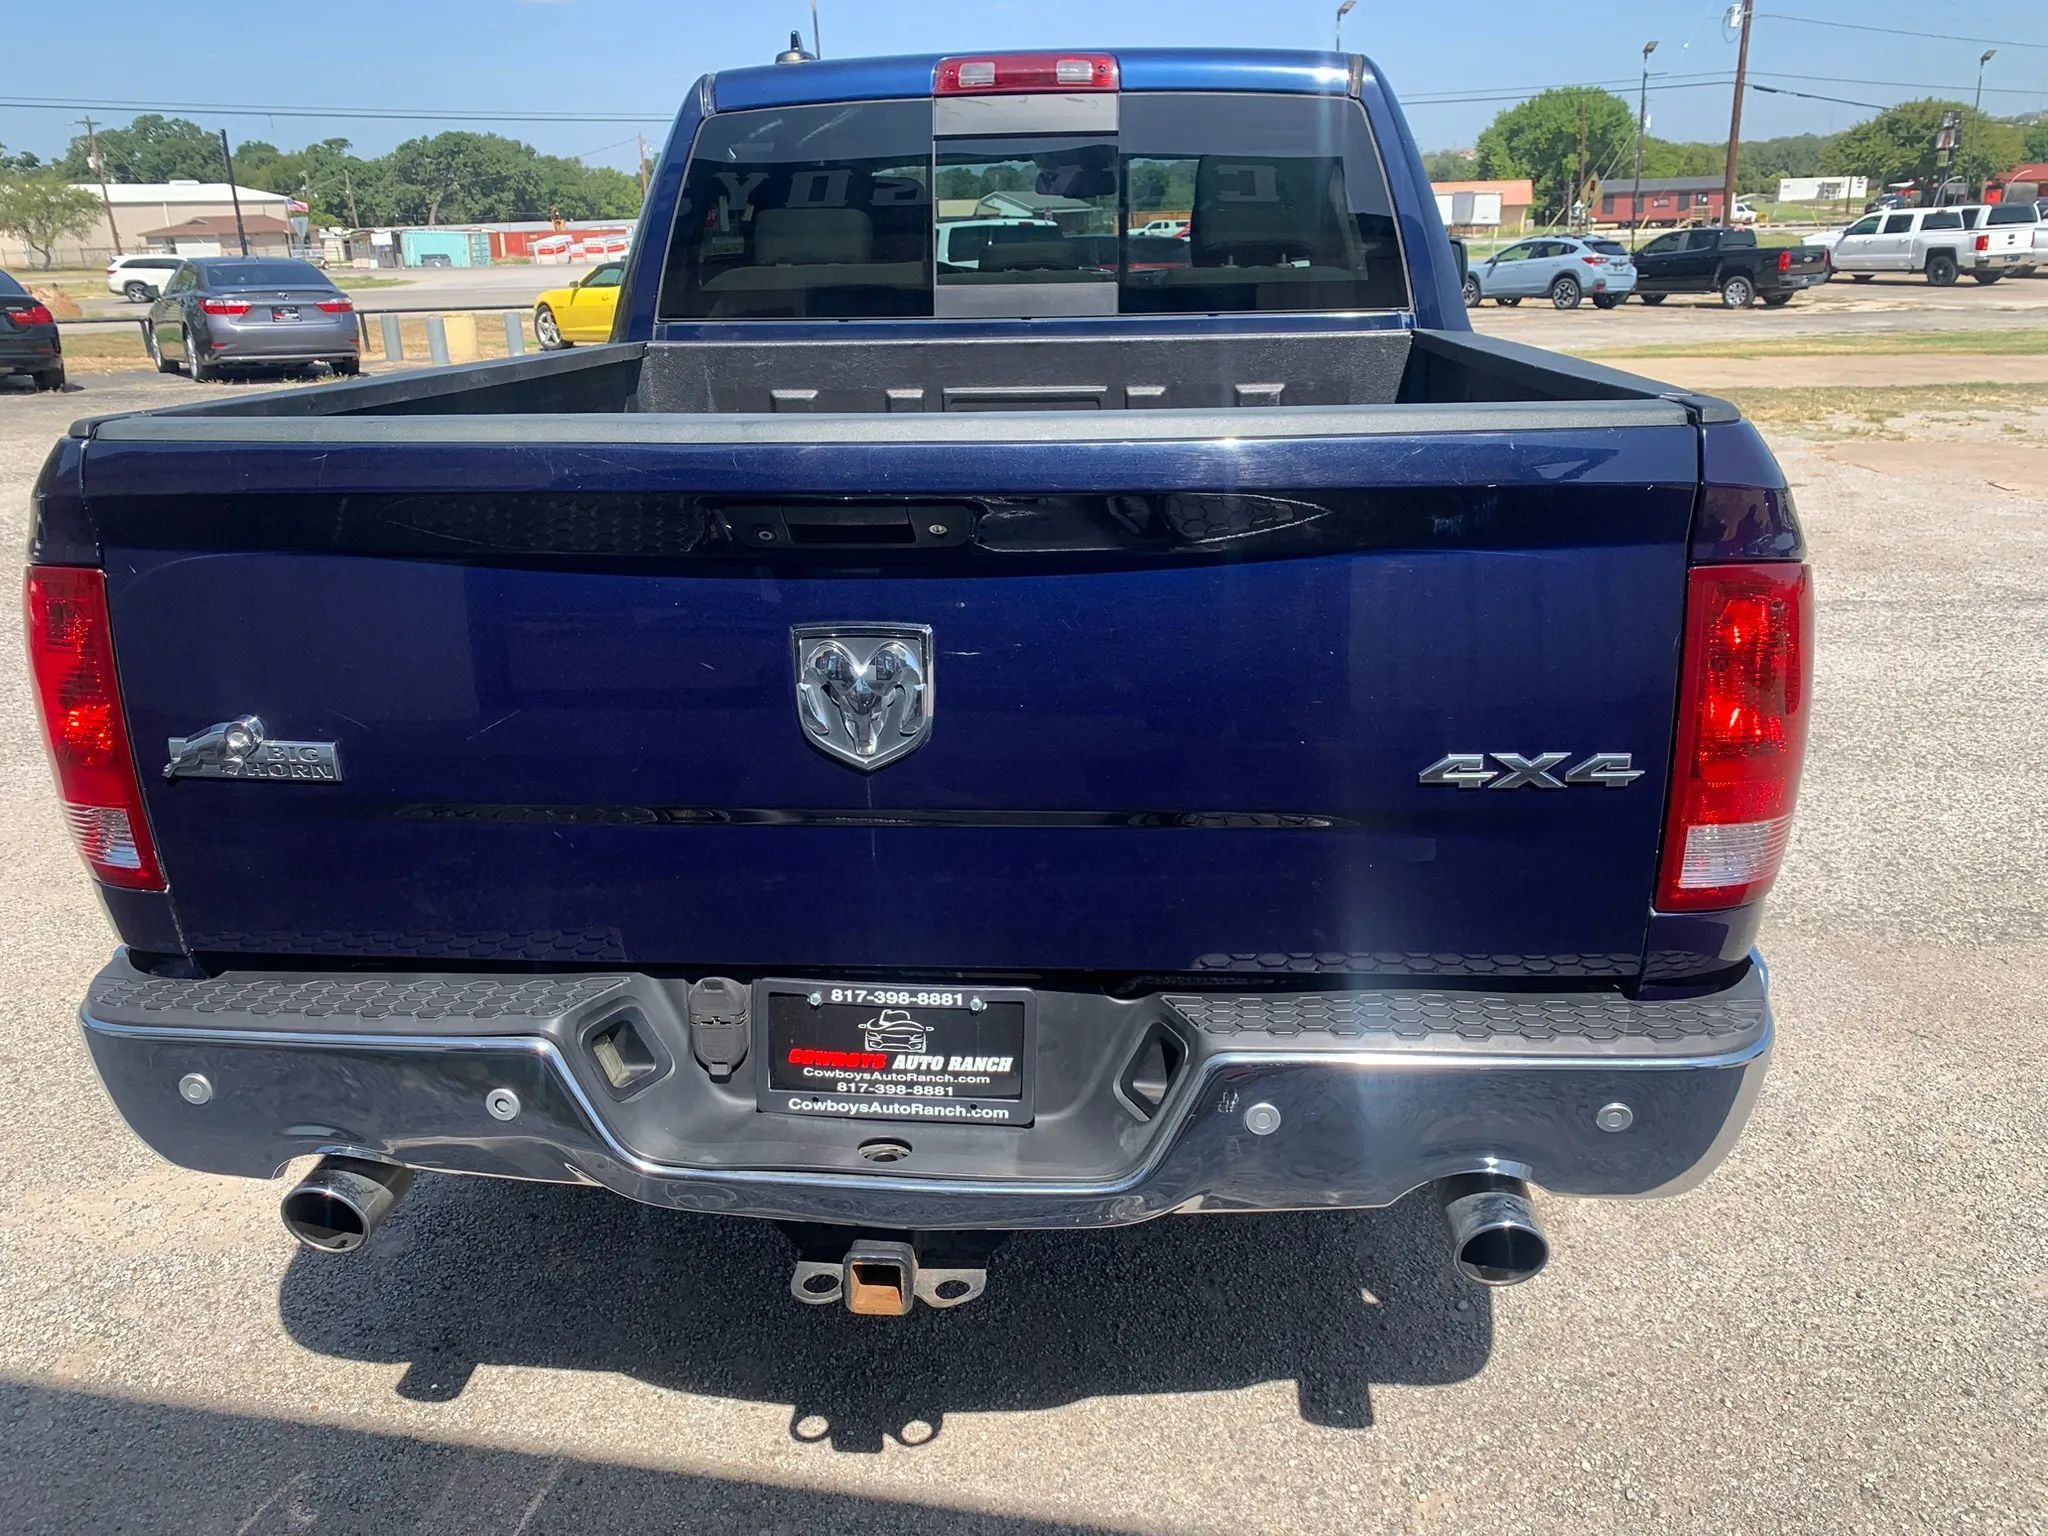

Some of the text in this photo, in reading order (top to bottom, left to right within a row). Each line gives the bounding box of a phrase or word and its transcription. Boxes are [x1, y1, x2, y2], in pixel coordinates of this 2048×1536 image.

[266, 746, 319, 763] BIG
[246, 762, 334, 779] HORN
[1419, 752, 1645, 789] 4X4
[830, 988, 963, 1007] 817-398-8881
[892, 1055, 945, 1071] AUTO
[947, 1056, 1013, 1073] RANCH
[803, 1066, 990, 1084] CowboysAutoRanch.com
[836, 1081, 954, 1097] 817-398-8881
[788, 1098, 1009, 1120] CowboysAutoRanch.com
